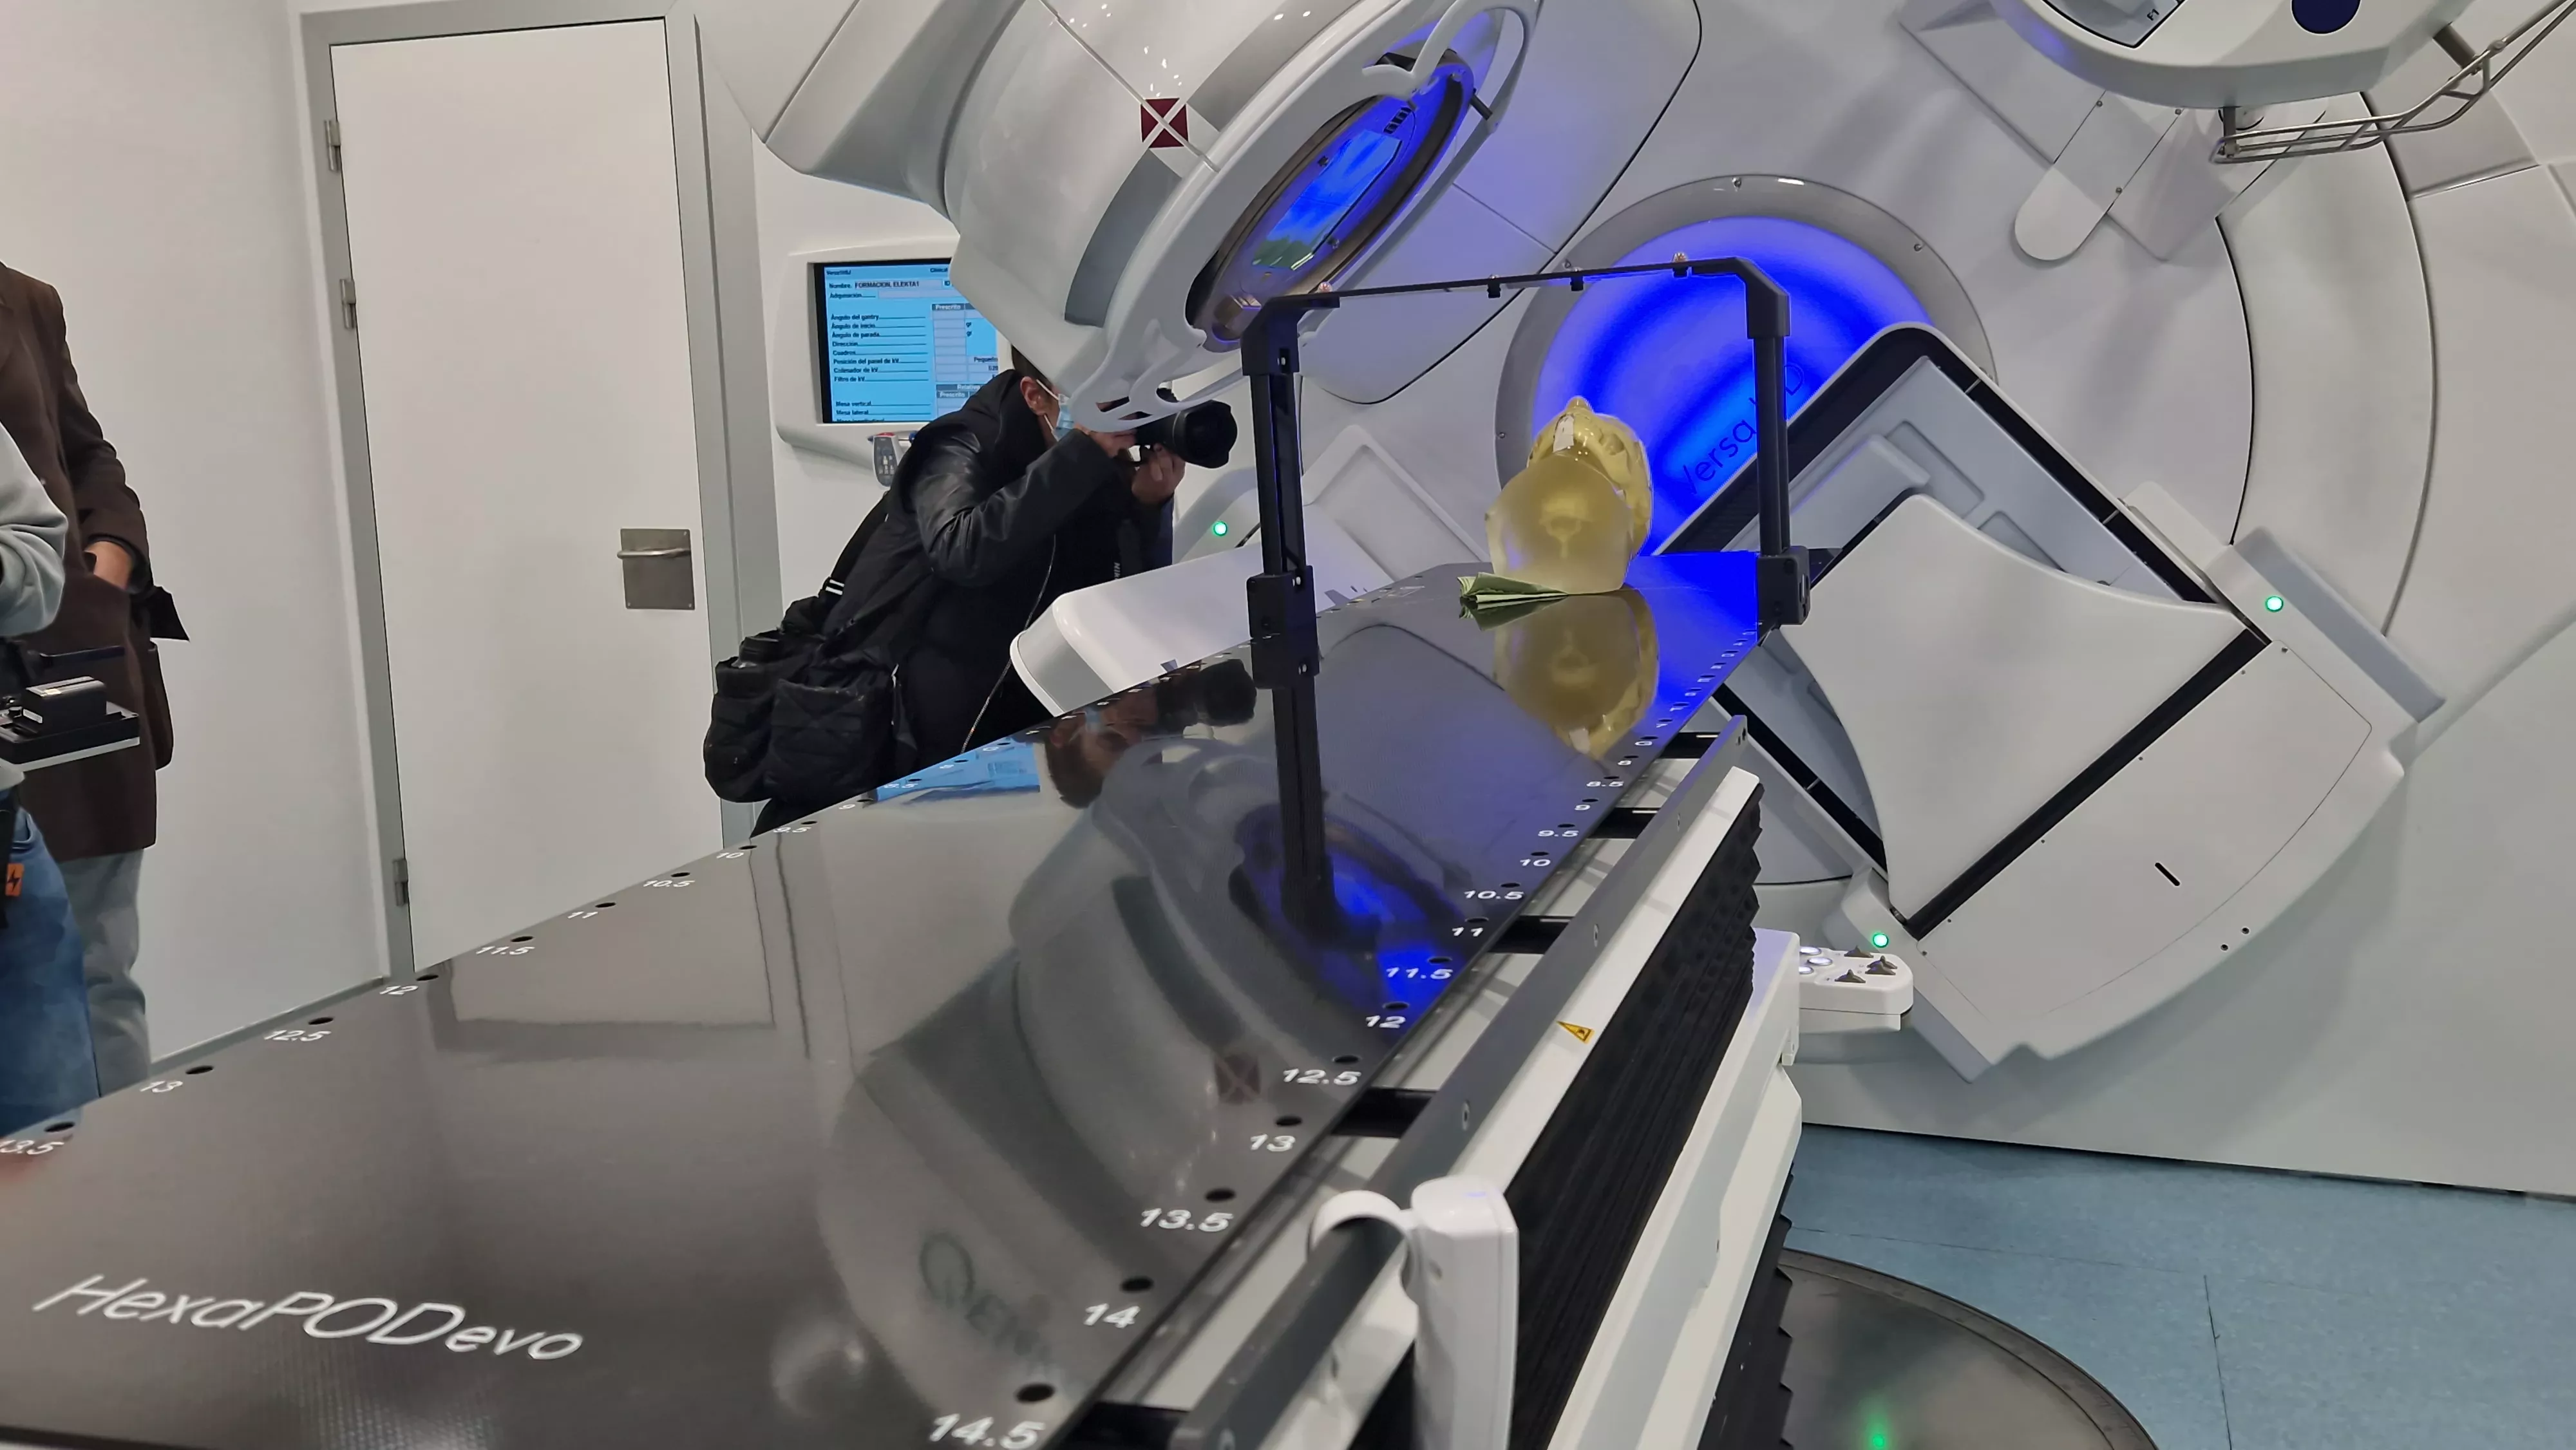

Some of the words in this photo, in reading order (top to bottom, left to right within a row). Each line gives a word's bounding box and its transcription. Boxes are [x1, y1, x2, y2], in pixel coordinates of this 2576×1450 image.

[2146, 8, 2159, 21] F1
[716, 851, 744, 860] 10
[1520, 858, 1551, 867] 10
[1464, 890, 1524, 899] 10.5
[1452, 927, 1483, 937] 11
[476, 946, 535, 955] 11.5
[1387, 967, 1454, 979] 11.5
[379, 985, 419, 995] 12
[1366, 1015, 1406, 1028] 12
[264, 1030, 331, 1042] 12.5
[1283, 1068, 1361, 1086] 12.5
[140, 1080, 184, 1093] 13
[1251, 1134, 1296, 1151] 13
[1141, 1208, 1233, 1232] 13.5
[32, 1274, 583, 1360] HexaPODevo
[1085, 1303, 1139, 1328] 14
[930, 1413, 1045, 1449] 14.5
